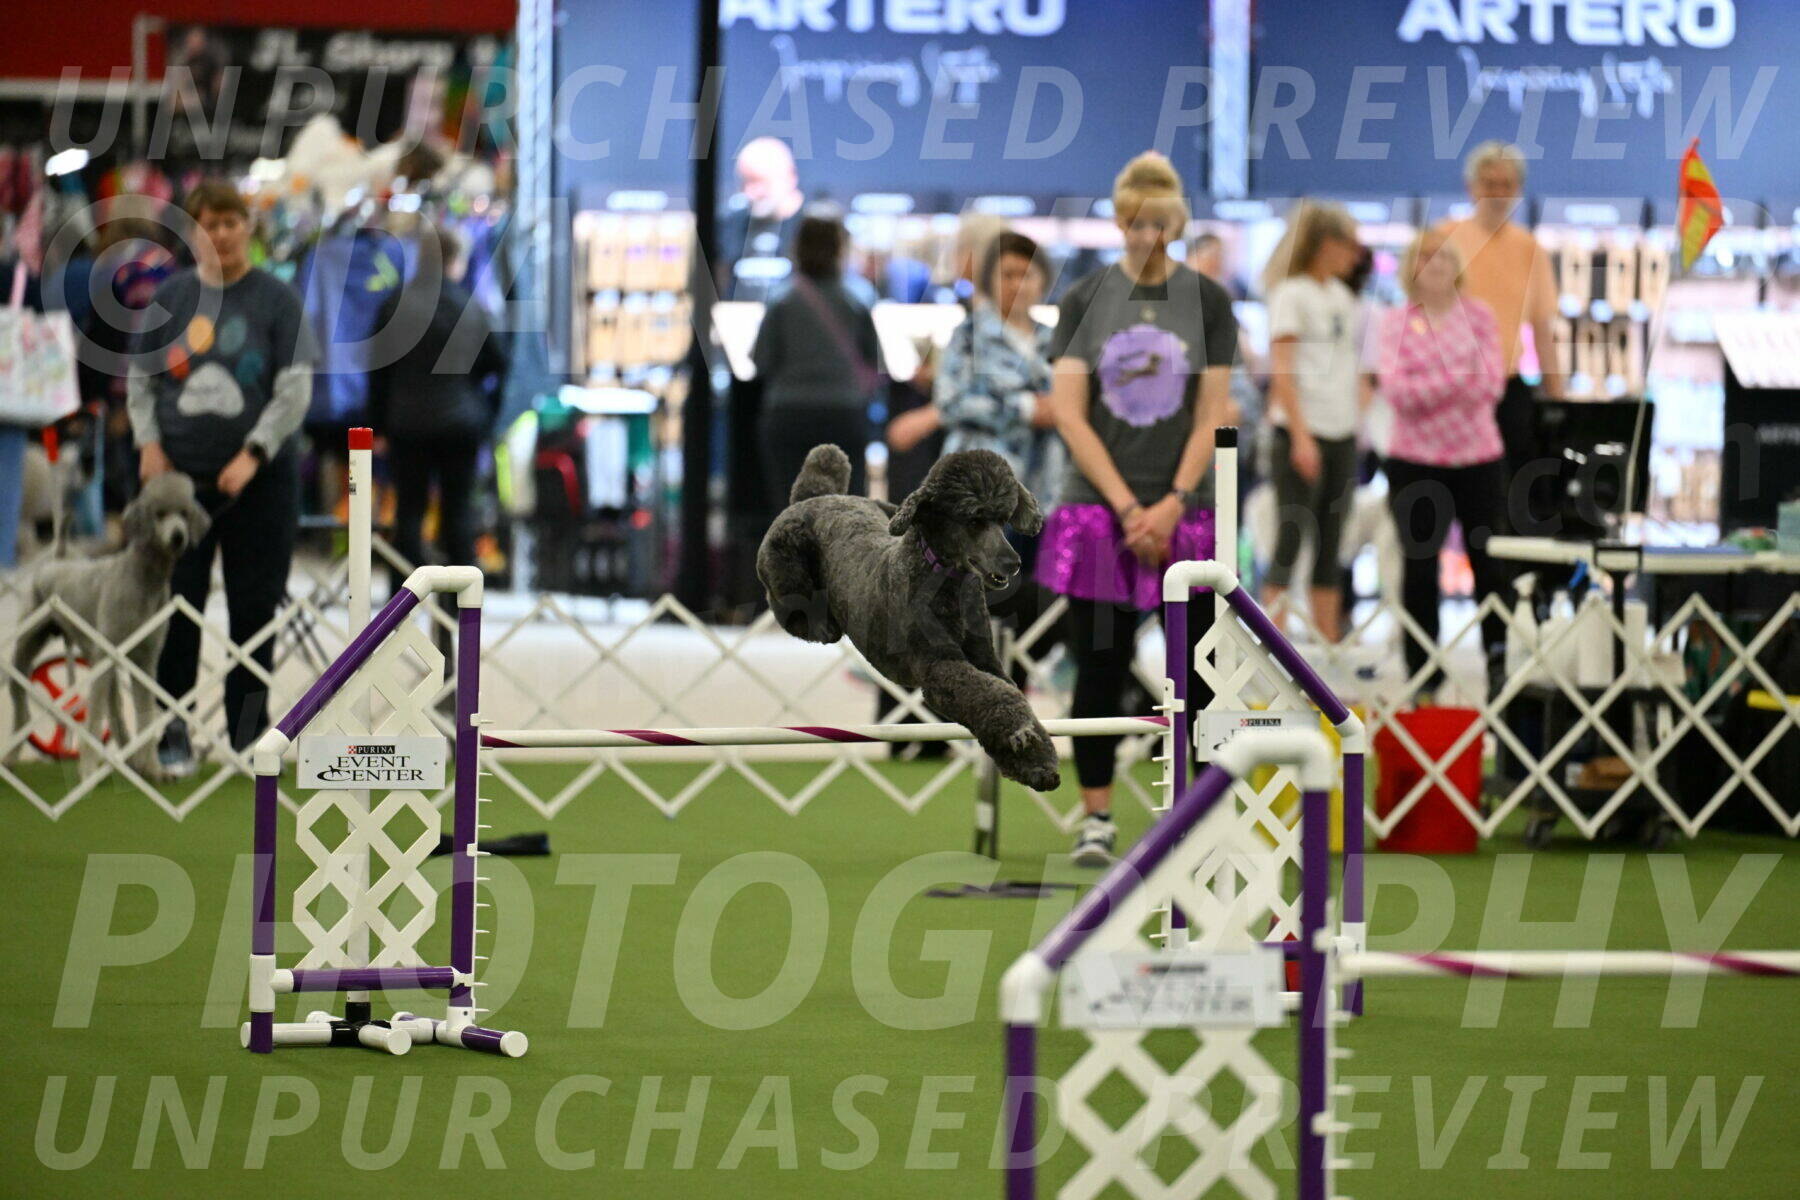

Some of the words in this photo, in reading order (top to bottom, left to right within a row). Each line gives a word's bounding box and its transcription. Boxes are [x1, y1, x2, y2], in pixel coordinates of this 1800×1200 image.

[1397, 0, 1736, 49] ARTERO
[358, 746, 394, 754] PURINA
[336, 755, 411, 768] EVENT
[317, 767, 424, 781] CENTER
